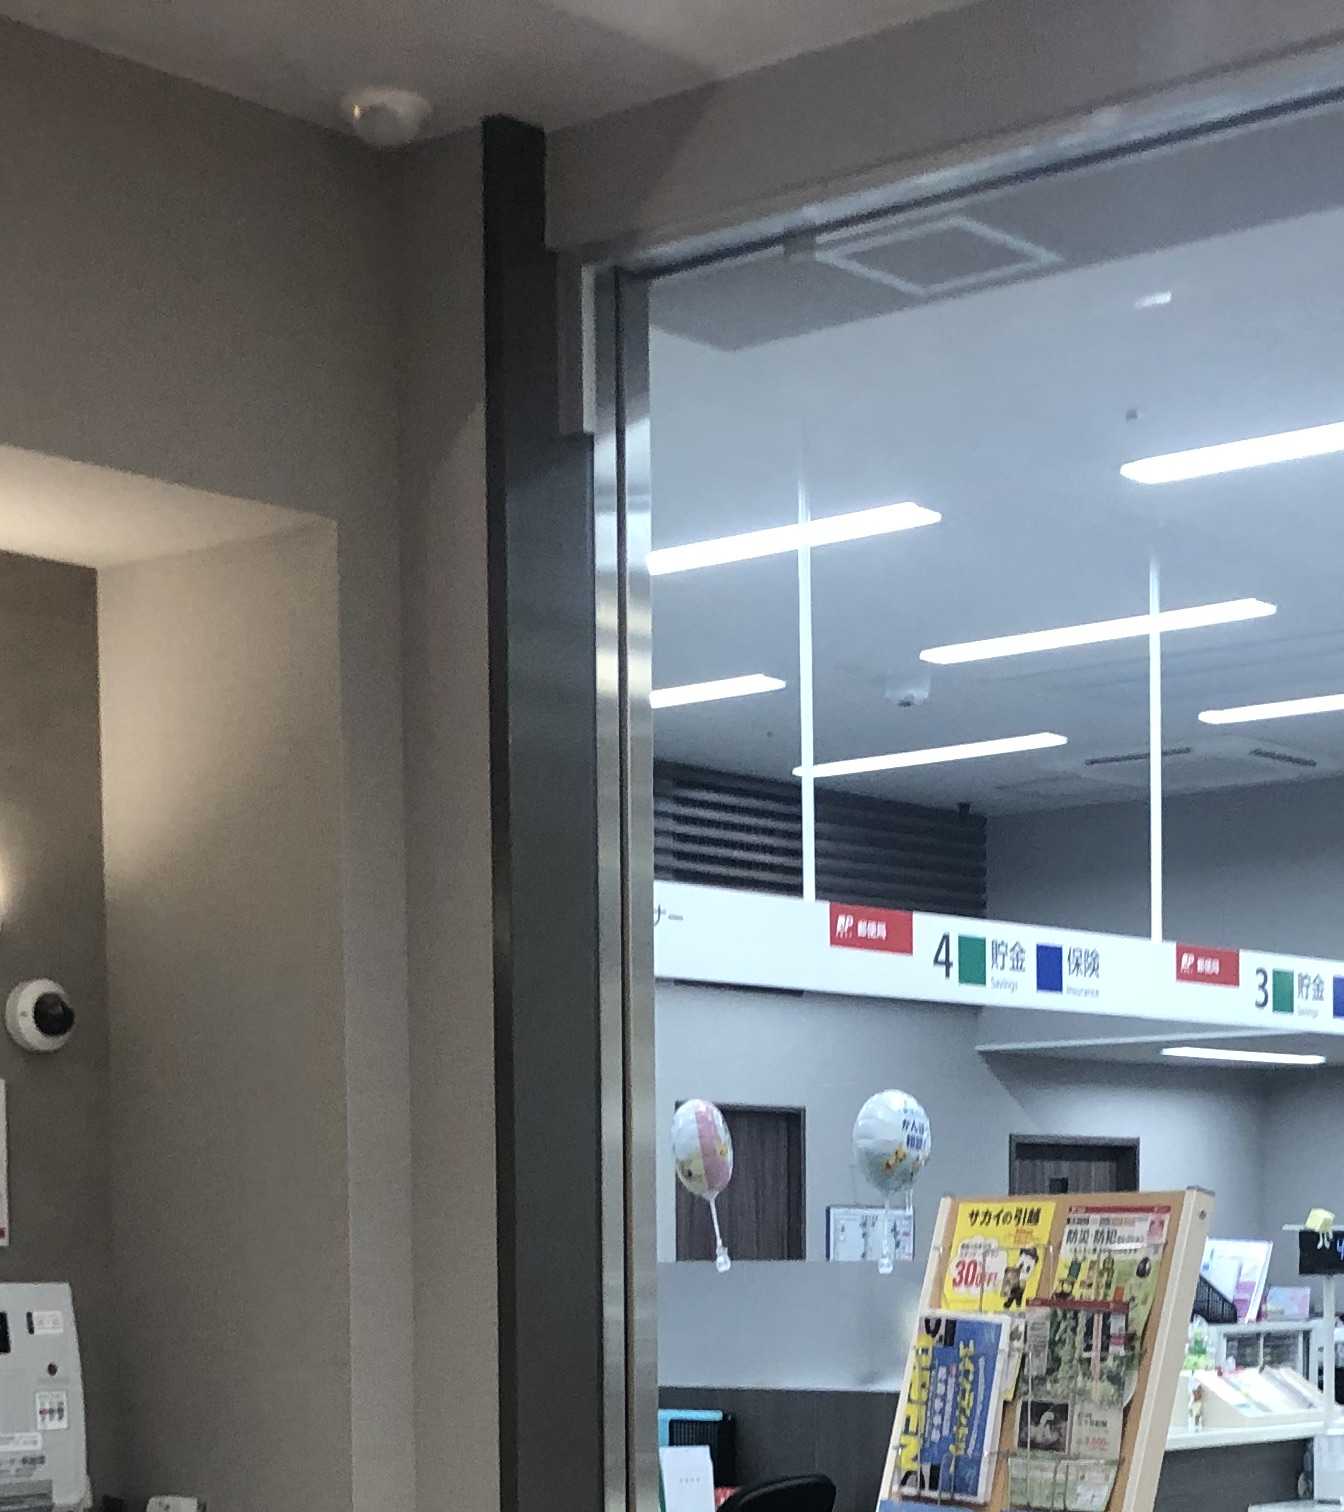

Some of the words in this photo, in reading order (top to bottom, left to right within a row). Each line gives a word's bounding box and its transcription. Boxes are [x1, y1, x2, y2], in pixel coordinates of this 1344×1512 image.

[933, 931, 954, 980] 4
[991, 939, 1027, 973] 貯金
[1067, 946, 1100, 979] 保険
[1255, 967, 1269, 1010] 3
[1297, 972, 1325, 1002] 貯金
